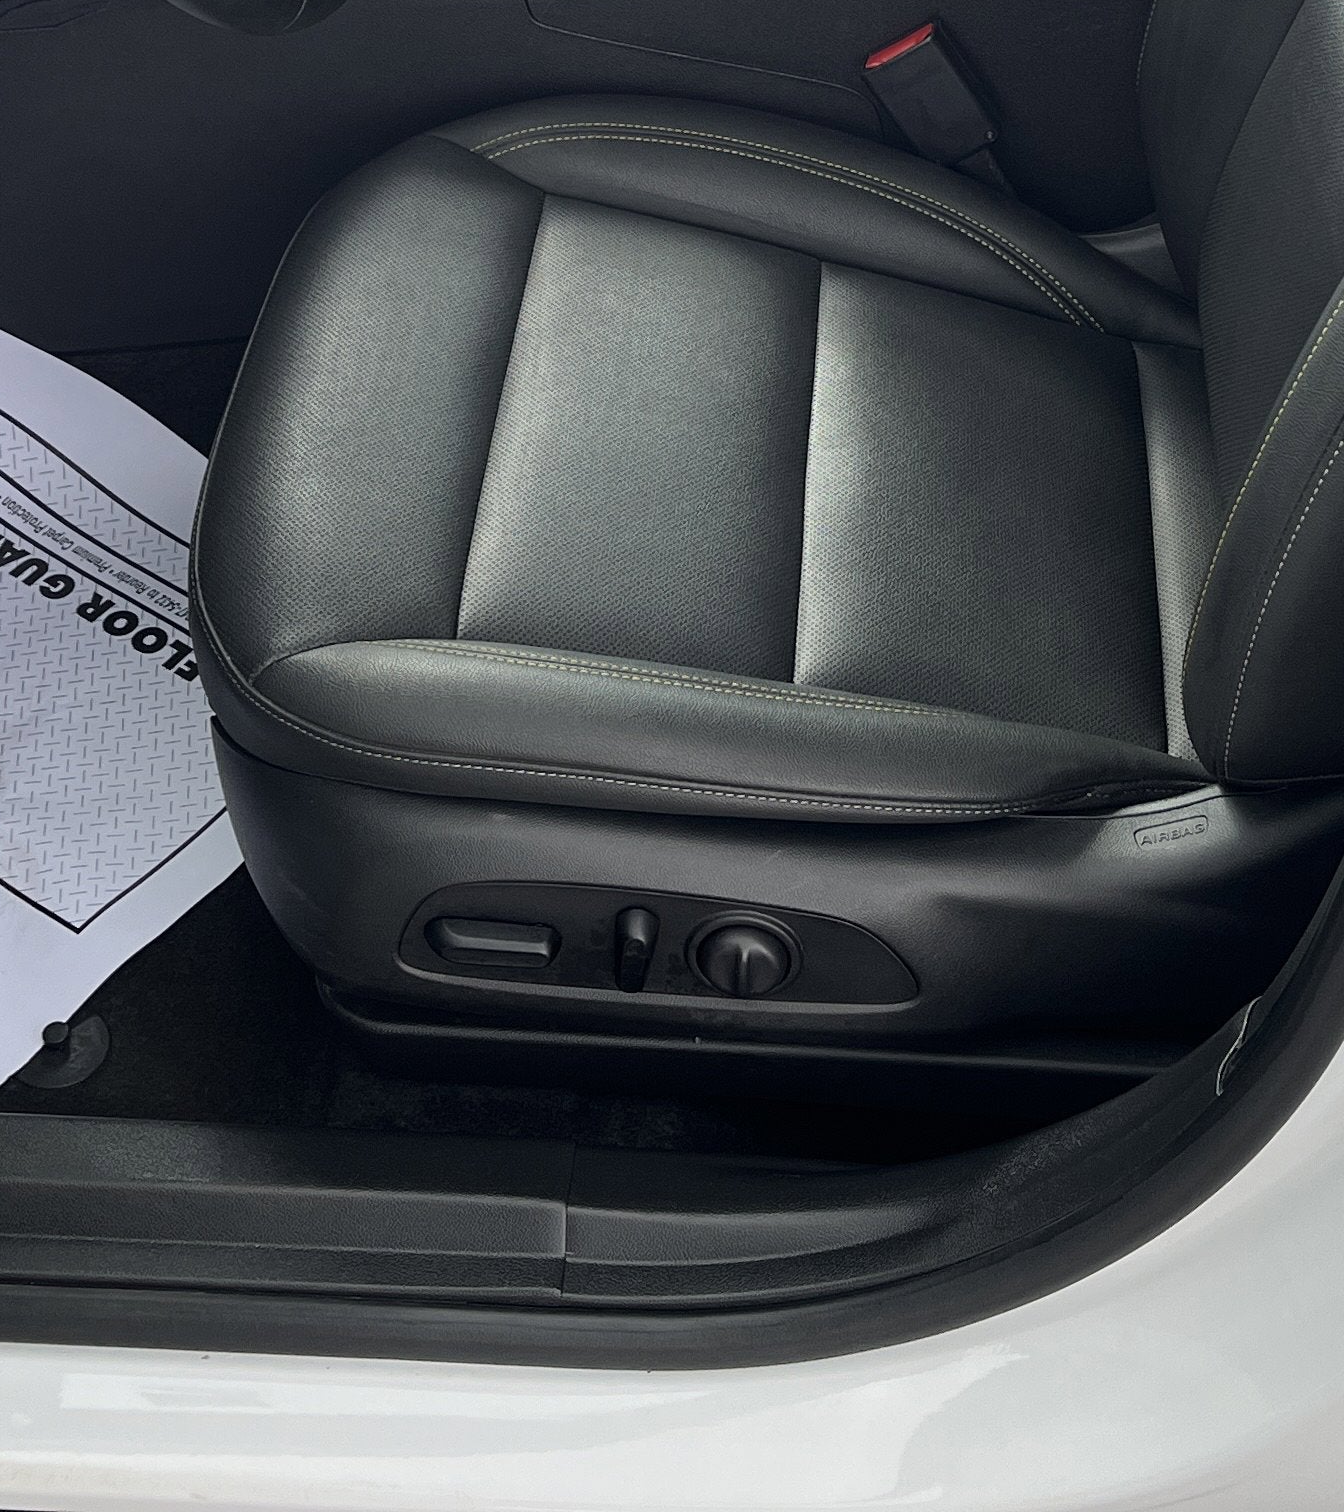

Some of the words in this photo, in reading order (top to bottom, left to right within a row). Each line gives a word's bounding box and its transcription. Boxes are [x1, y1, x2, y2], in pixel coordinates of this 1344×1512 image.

[1, 496, 48, 534] Protection
[47, 526, 74, 550] Carpet
[72, 545, 111, 573] Premium
[114, 570, 150, 595] Reorder
[147, 590, 159, 600] to
[154, 595, 189, 621] 47-5432
[76, 591, 200, 682] FLOOR
[1140, 823, 1206, 847] AIRBAG
